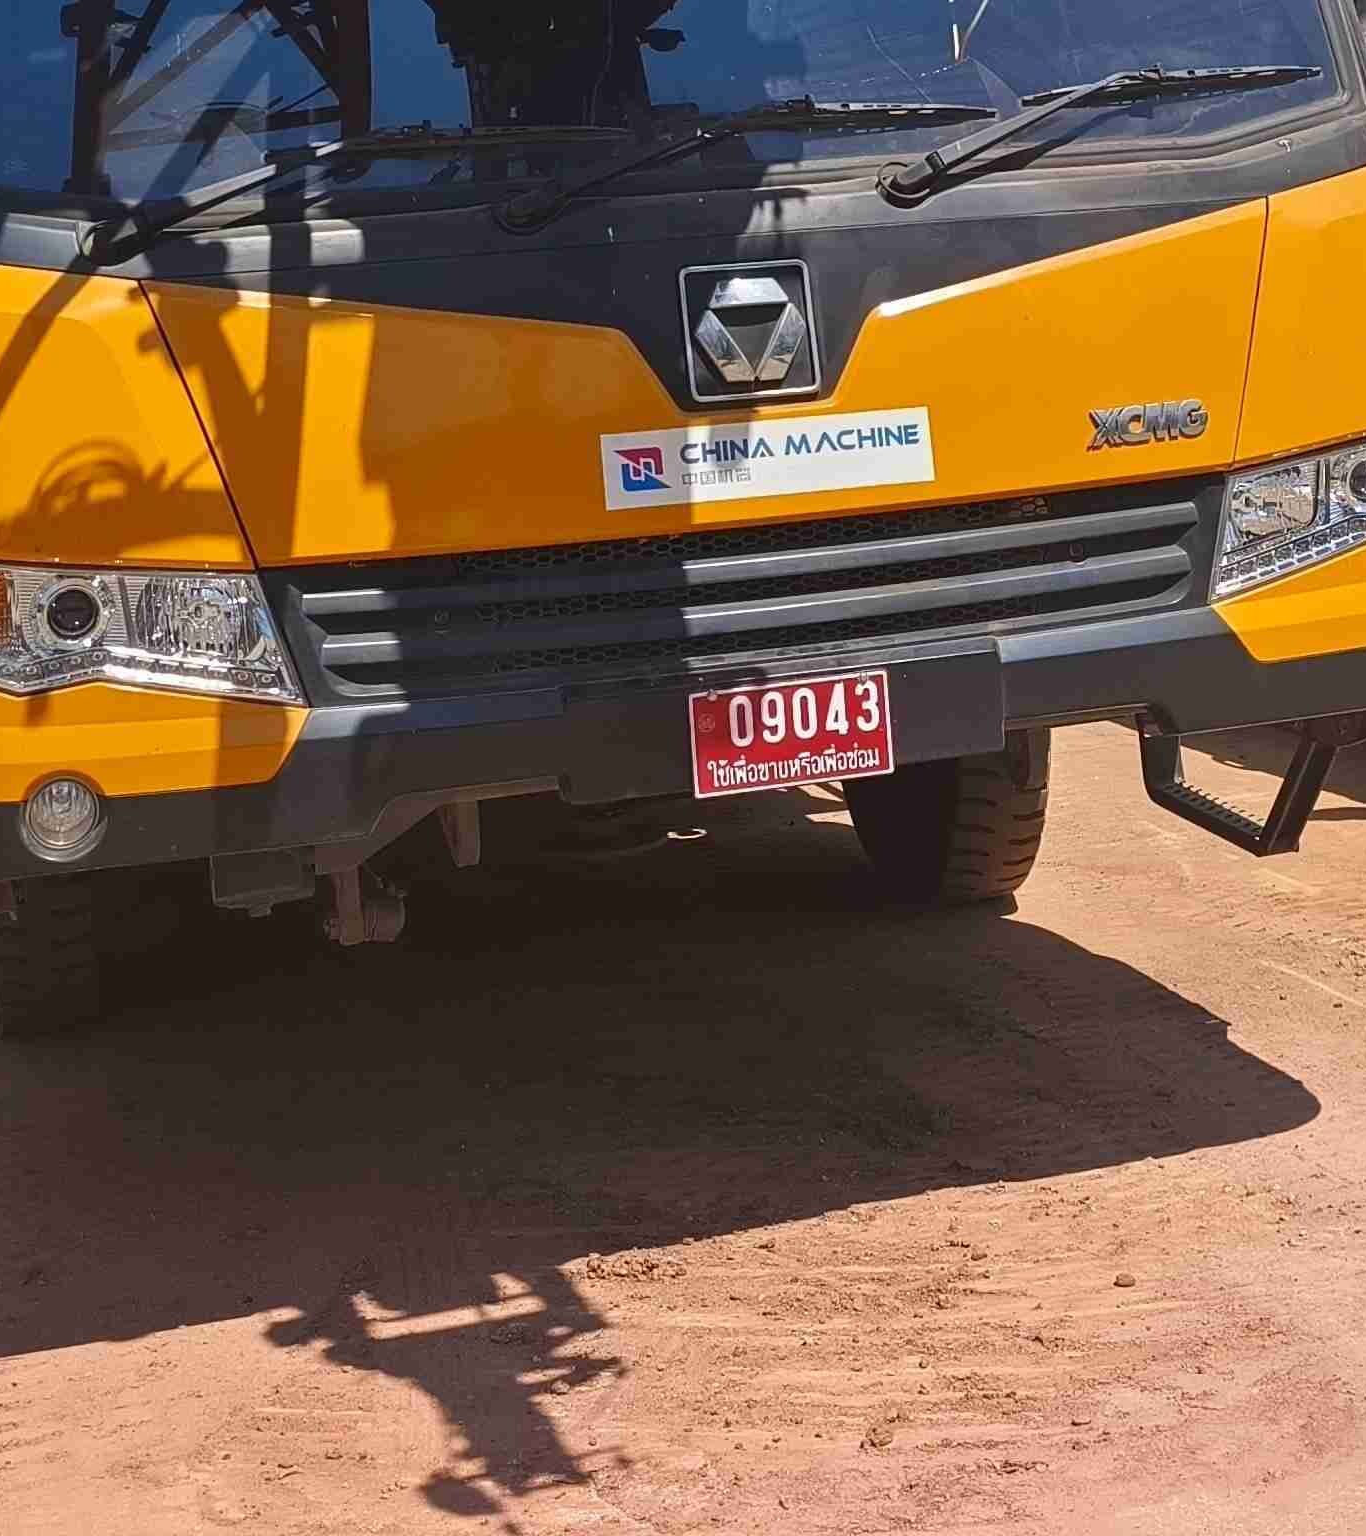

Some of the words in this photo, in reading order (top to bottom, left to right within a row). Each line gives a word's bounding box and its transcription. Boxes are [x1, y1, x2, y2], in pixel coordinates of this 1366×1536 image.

[680, 437, 775, 465] CHINA
[784, 424, 920, 456] MACHINE
[1087, 399, 1210, 452] XCMG
[729, 680, 880, 748] 09043
[707, 742, 880, 788] ใช้เพื่อขายหรือเพื่อซ่อม
